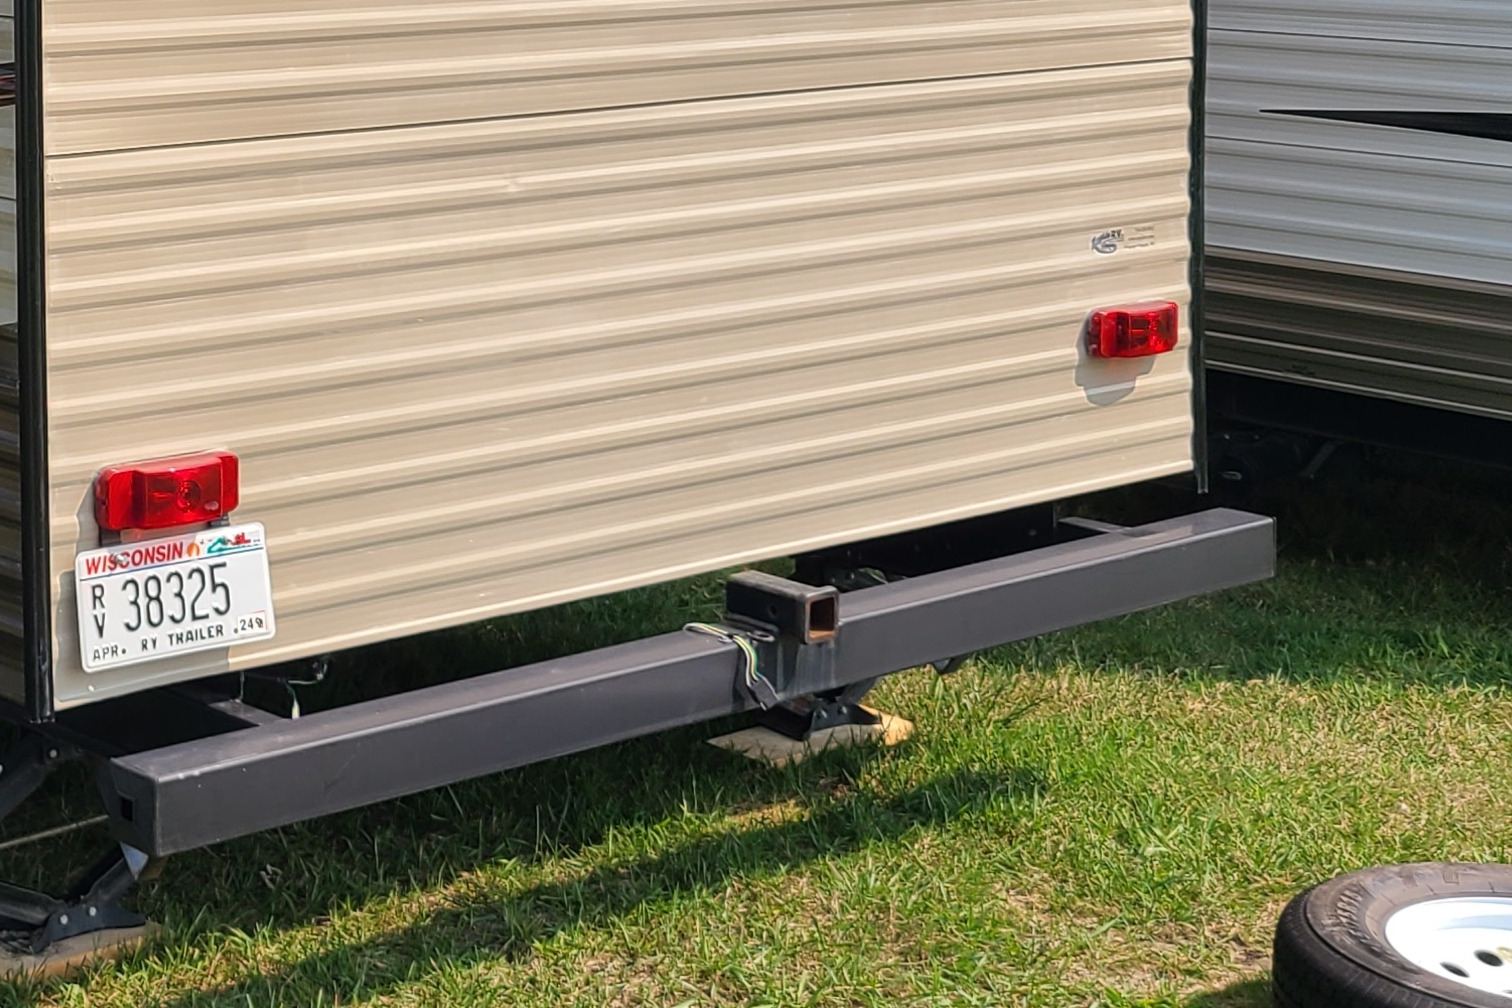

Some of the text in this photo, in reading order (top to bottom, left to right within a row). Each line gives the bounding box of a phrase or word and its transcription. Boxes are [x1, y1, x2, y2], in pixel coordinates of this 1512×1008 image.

[85, 542, 184, 575] WISCONSIN
[121, 562, 231, 633] 38325
[168, 625, 225, 647] TRAILER
